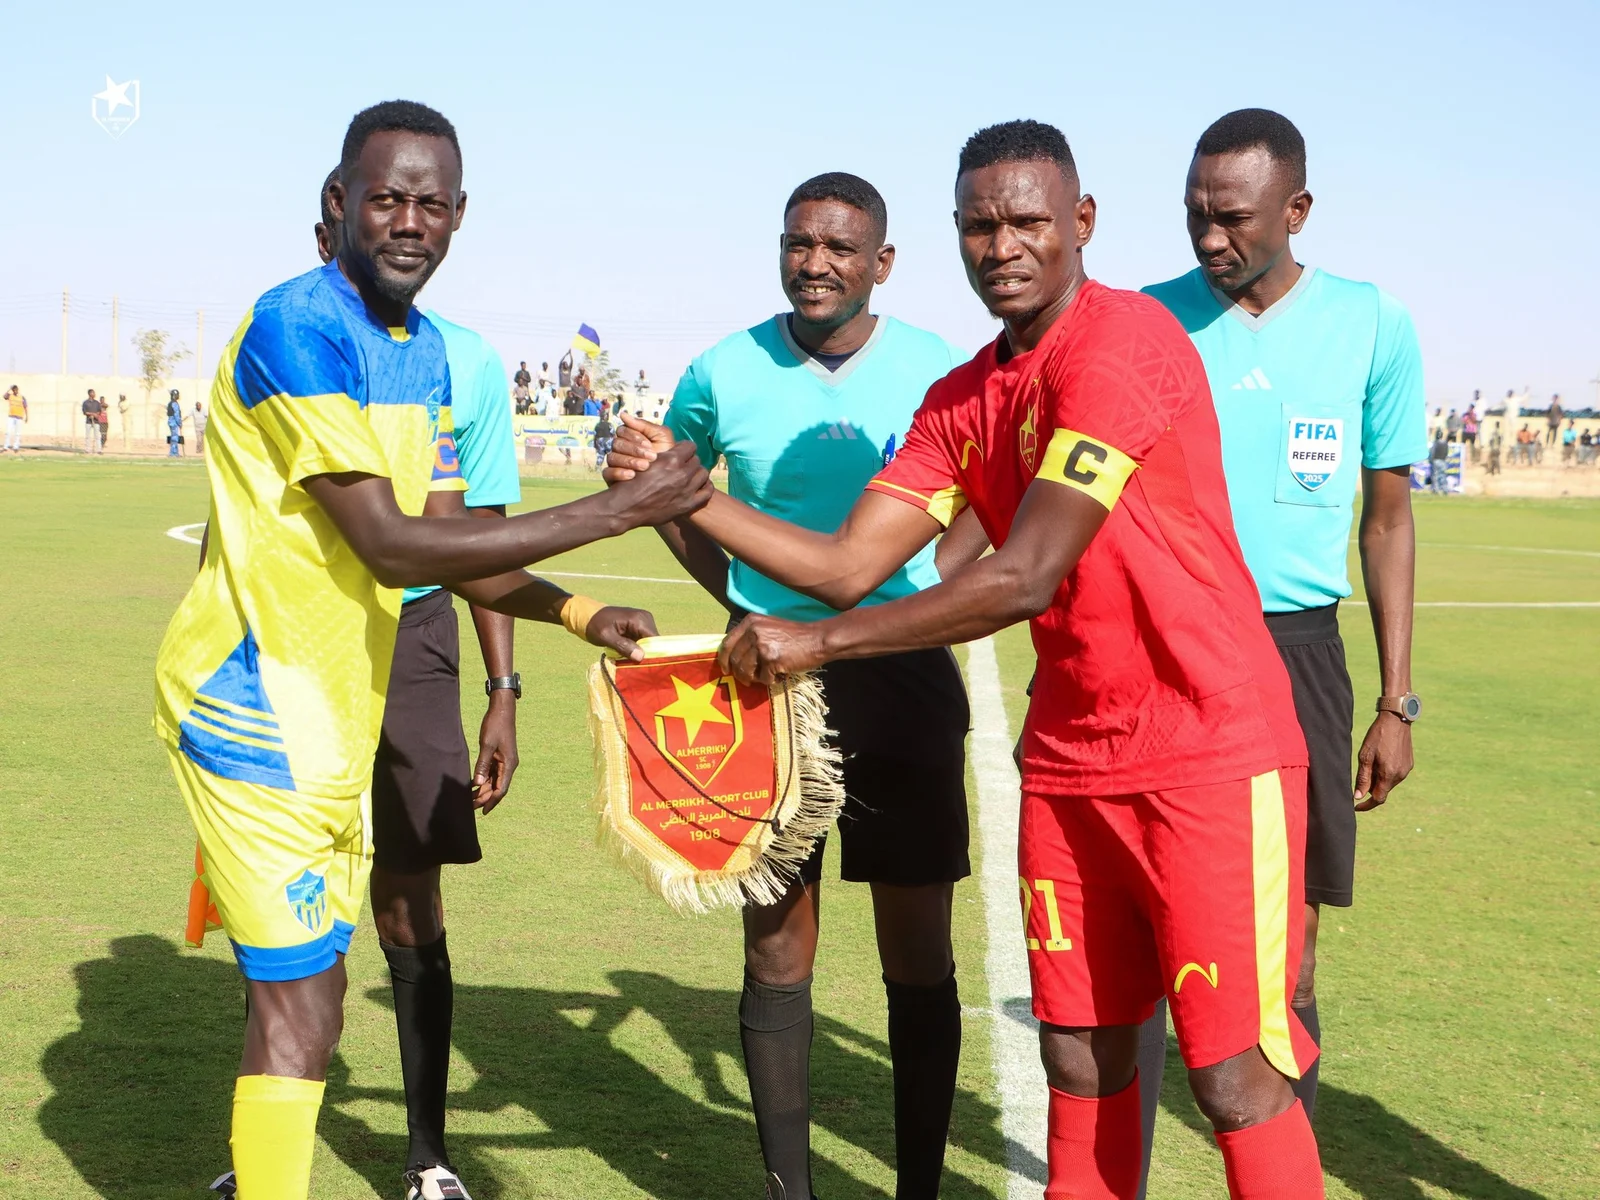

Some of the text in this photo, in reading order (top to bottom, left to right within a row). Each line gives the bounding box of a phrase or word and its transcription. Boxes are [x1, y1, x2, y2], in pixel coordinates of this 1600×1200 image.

[1294, 422, 1337, 440] FIFA
[435, 437, 459, 472] C
[1063, 440, 1108, 485] C
[1292, 451, 1336, 461] REFEREE
[1303, 474, 1323, 483] 2025
[676, 744, 727, 758] ALMERRIKH
[641, 803, 653, 811] AL
[656, 797, 704, 810] MERRIKH
[742, 790, 769, 800] CLUB
[659, 806, 751, 830] نادي المريخ الرياضي
[690, 828, 720, 841] 1908
